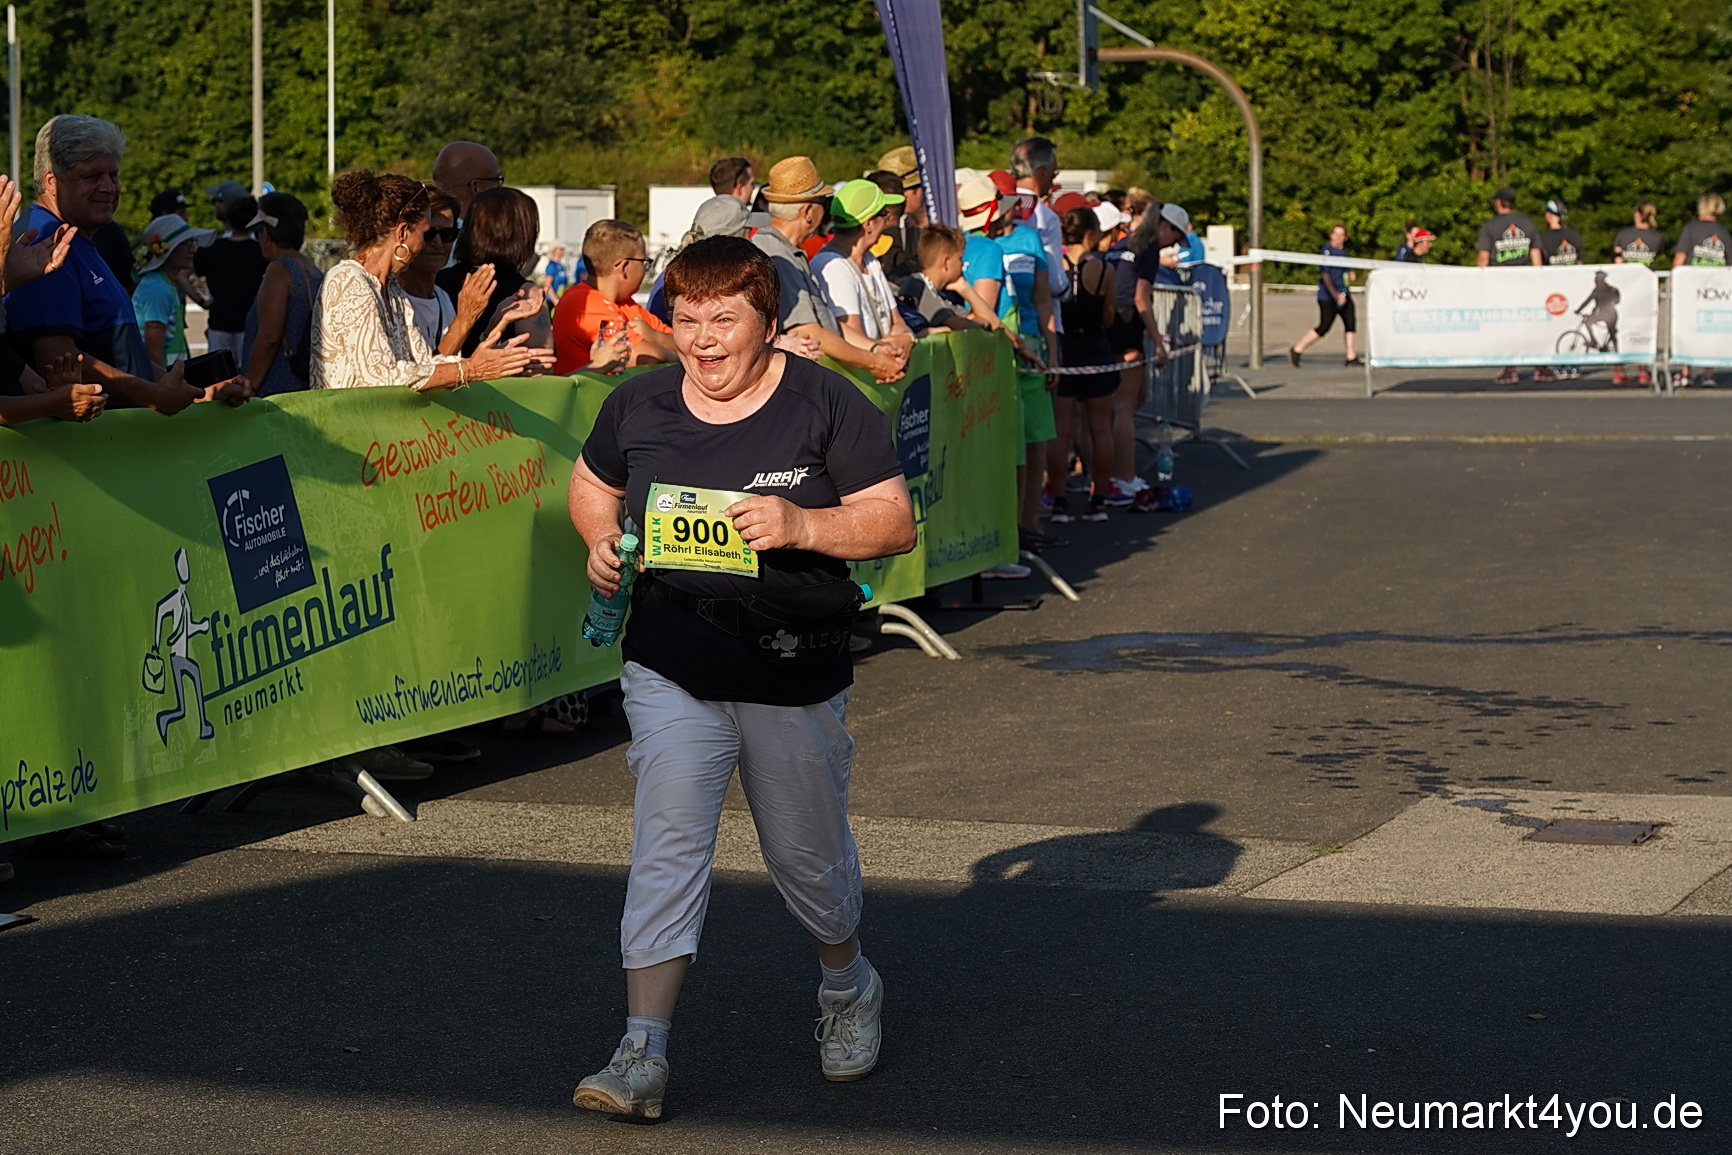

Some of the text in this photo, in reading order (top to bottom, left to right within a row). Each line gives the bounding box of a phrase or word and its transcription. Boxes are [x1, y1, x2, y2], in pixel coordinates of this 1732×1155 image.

[362, 410, 519, 487] Gesunde Firmen
[416, 440, 556, 532] laufen länger!
[743, 471, 794, 490] JURA
[234, 504, 286, 540] Fischer
[674, 503, 708, 511] Firmenlauf
[244, 526, 287, 552] AUTOMOBILE
[652, 517, 662, 556] WALK
[672, 516, 729, 547] 900
[663, 543, 741, 560] Röhrl Elisabeth
[211, 543, 396, 691] firmenlauf
[223, 666, 304, 726] neumarkt
[356, 636, 563, 725] www.firmenlauf-oberpfalz.de
